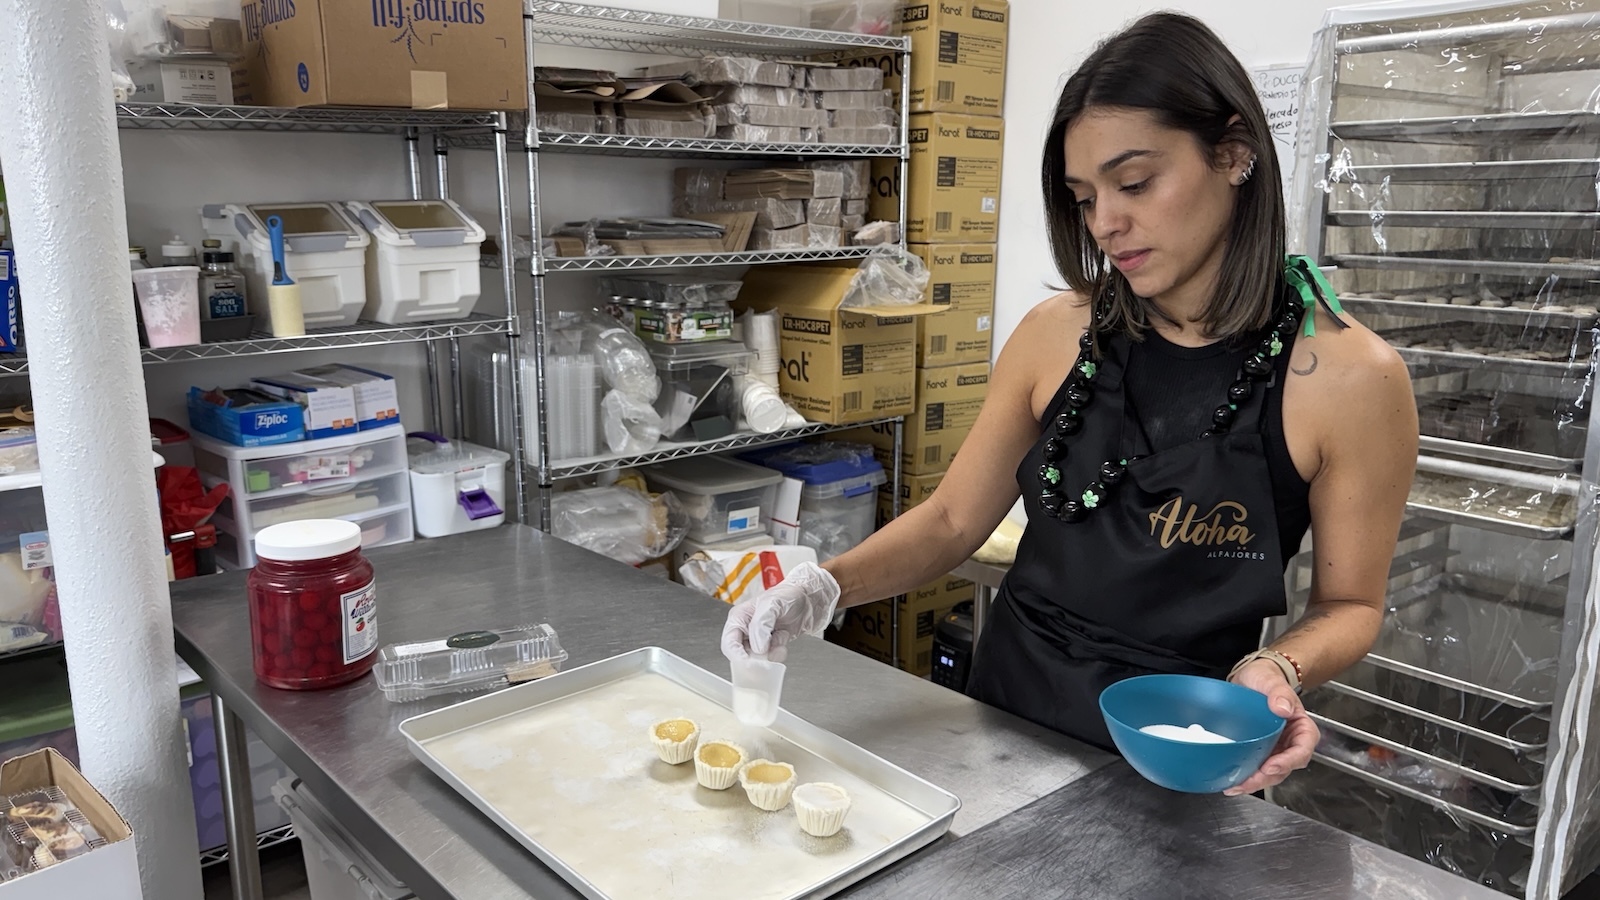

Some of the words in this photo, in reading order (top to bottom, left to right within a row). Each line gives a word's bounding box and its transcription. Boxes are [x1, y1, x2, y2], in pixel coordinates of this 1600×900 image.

[940, 3, 963, 16] Karat
[938, 126, 960, 138] Karat
[934, 255, 954, 265] Karat
[215, 304, 239, 314] SALT
[8, 286, 18, 346] OREO
[784, 318, 829, 333] TR-HDC8PET
[841, 318, 867, 330] Karat
[926, 379, 948, 390] Karat
[257, 414, 288, 428] Ziploc
[1149, 496, 1255, 549] Aloha
[1207, 551, 1265, 560] ALFAJORES
[916, 588, 937, 600] Karat
